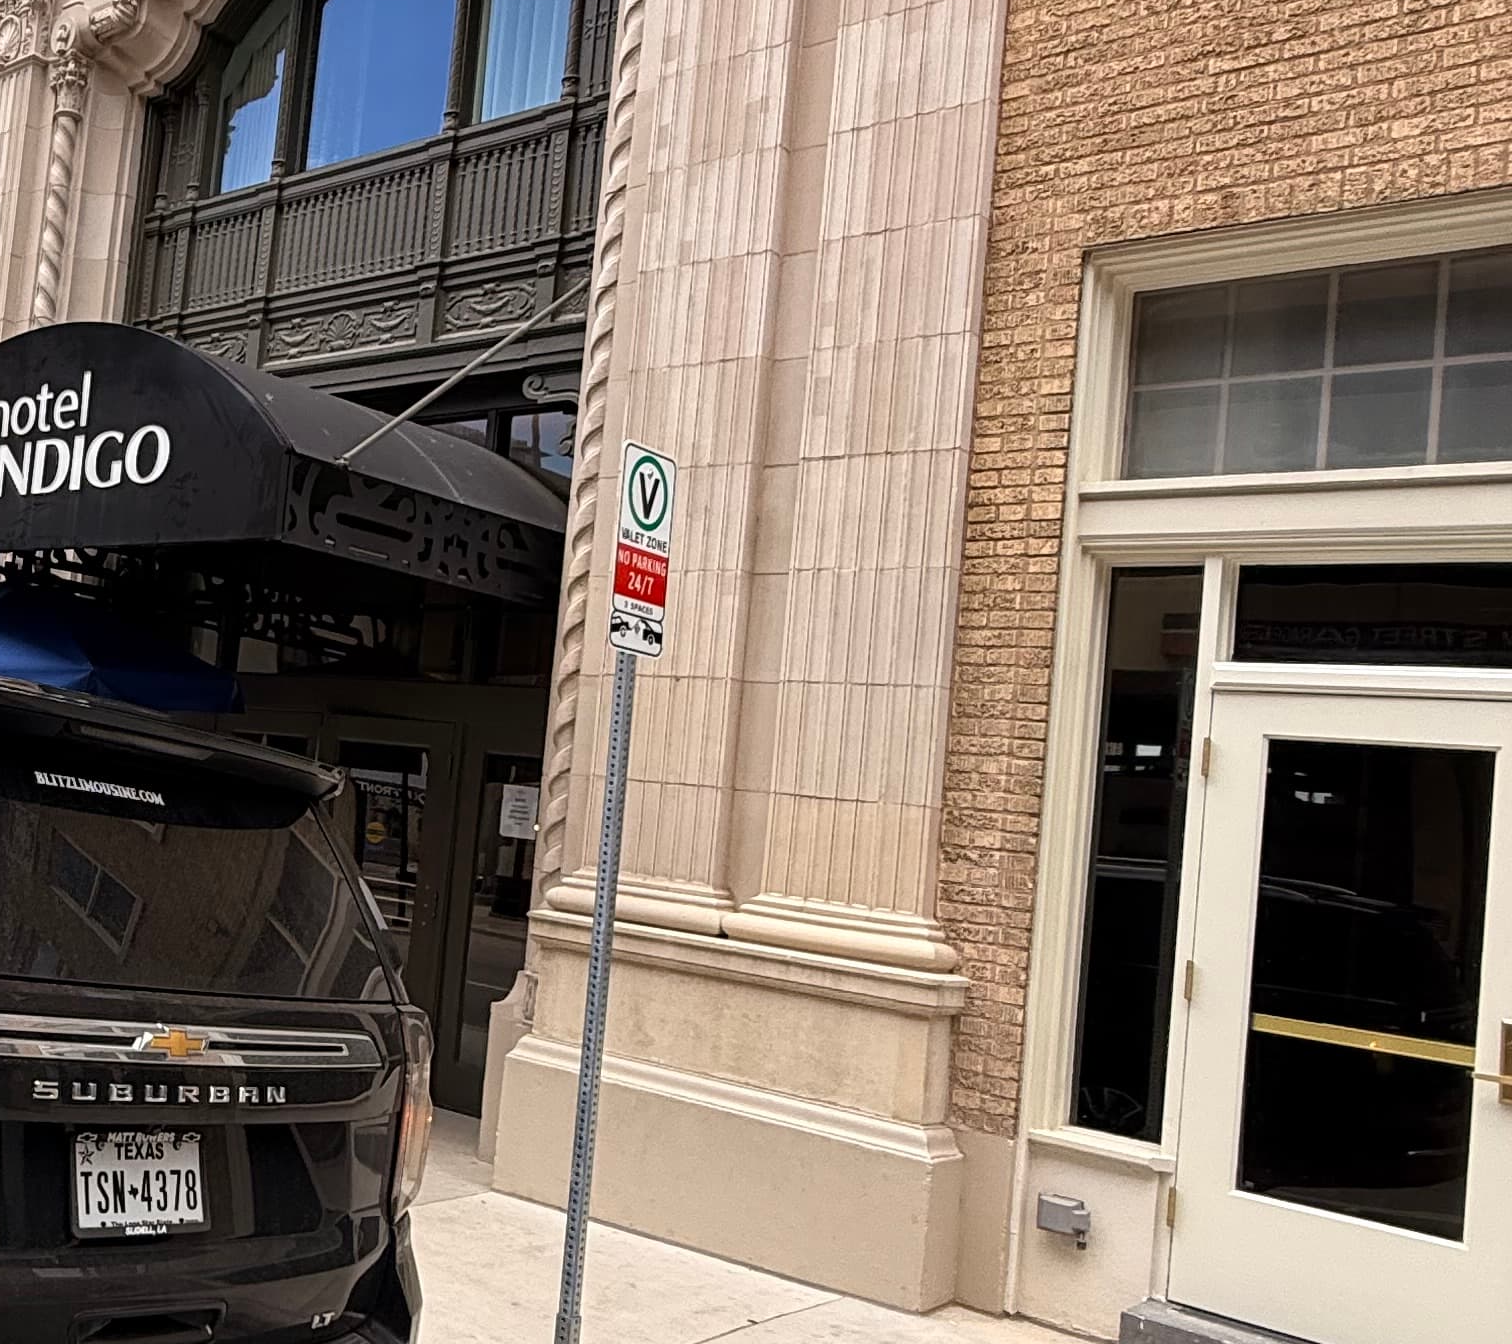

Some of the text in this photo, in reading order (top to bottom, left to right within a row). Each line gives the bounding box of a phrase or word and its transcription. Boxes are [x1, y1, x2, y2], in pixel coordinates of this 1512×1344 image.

[639, 470, 660, 520] V
[622, 527, 668, 554] VALET ZONE
[618, 549, 667, 577] NO PARKING
[628, 571, 655, 596] 24/7
[34, 771, 165, 806] BLITZLIMOUSINE.COM
[32, 1080, 286, 1104] SUBURBAN
[107, 1132, 136, 1143] MATT
[114, 1142, 165, 1161] TEXAS
[311, 1311, 336, 1330] LT
